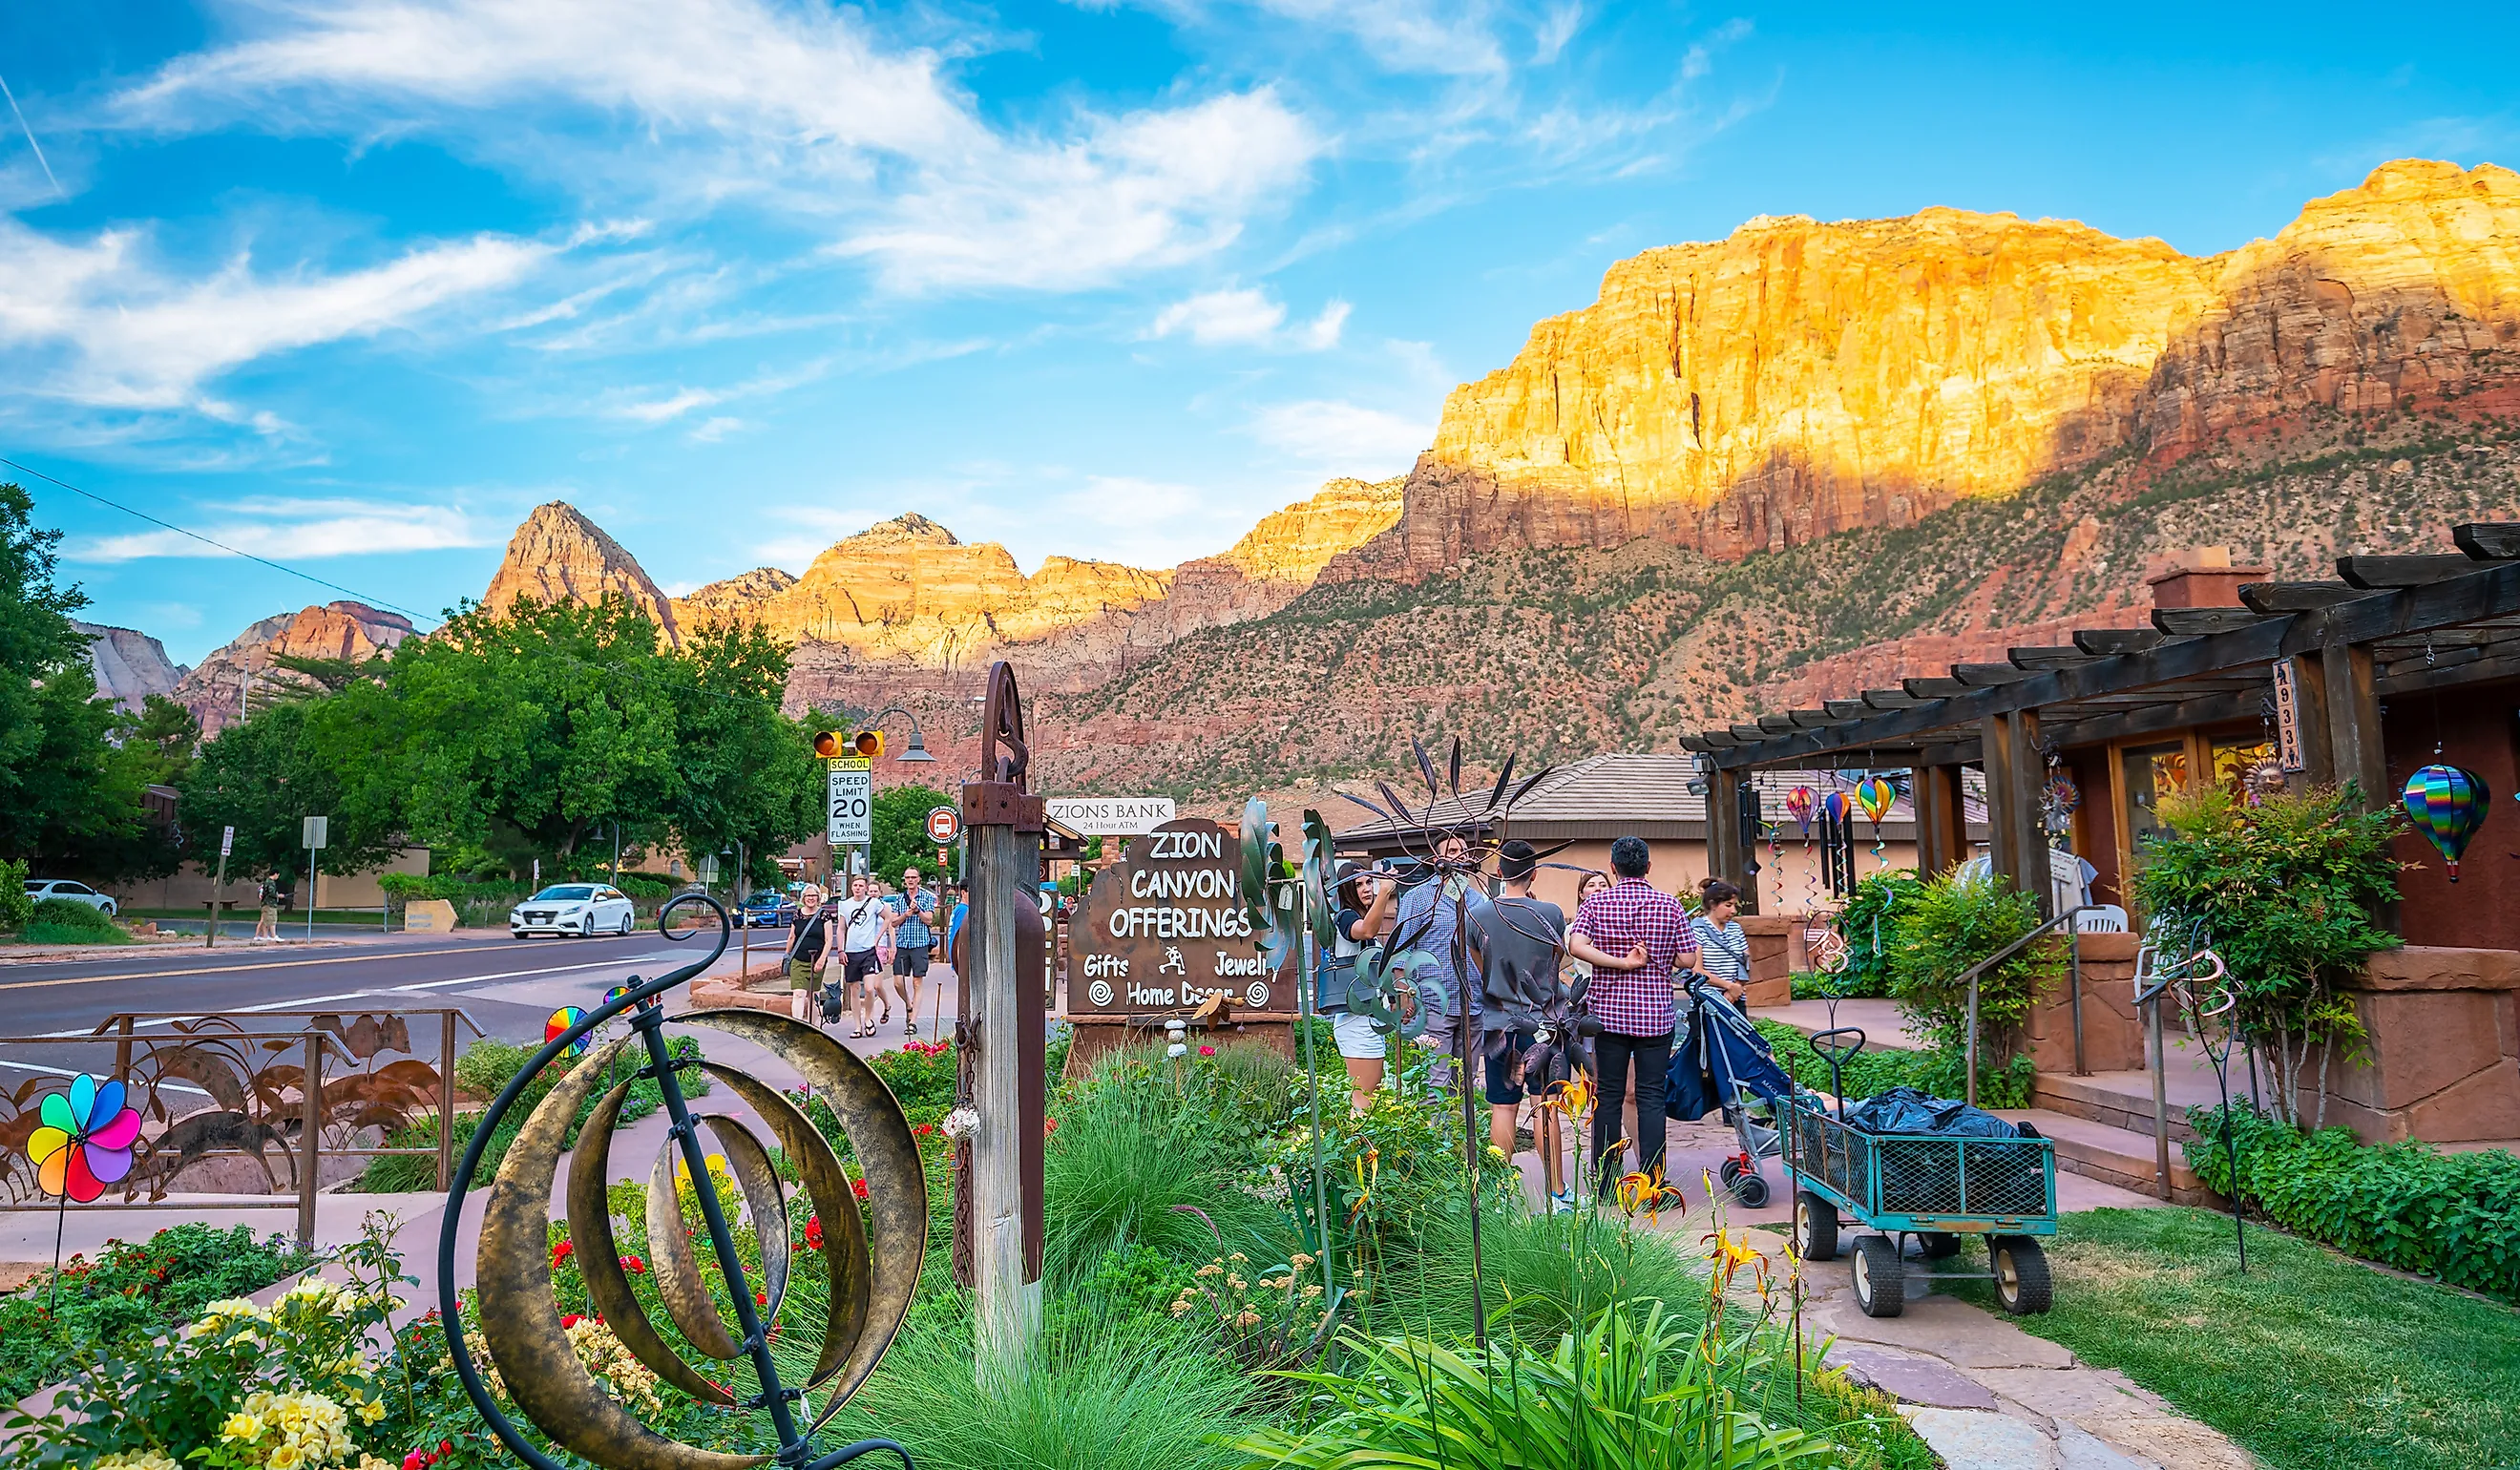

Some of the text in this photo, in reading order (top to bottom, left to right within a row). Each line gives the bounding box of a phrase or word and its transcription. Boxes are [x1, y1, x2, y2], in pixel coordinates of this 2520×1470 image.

[2280, 687, 2294, 745] 933
[831, 760, 868, 768] SCHOOL
[831, 776, 868, 786] SPEED
[835, 788, 863, 796] LIMIT
[832, 798, 867, 818] 20
[1052, 805, 1167, 818] ZIONS BANK
[1149, 831, 1221, 859] ZION
[939, 852, 946, 863] 5
[1130, 869, 1235, 899] CANYON
[1108, 907, 1253, 938] OFFERINGS
[1083, 954, 1129, 978] Gifts
[1125, 980, 1174, 1006] Home
